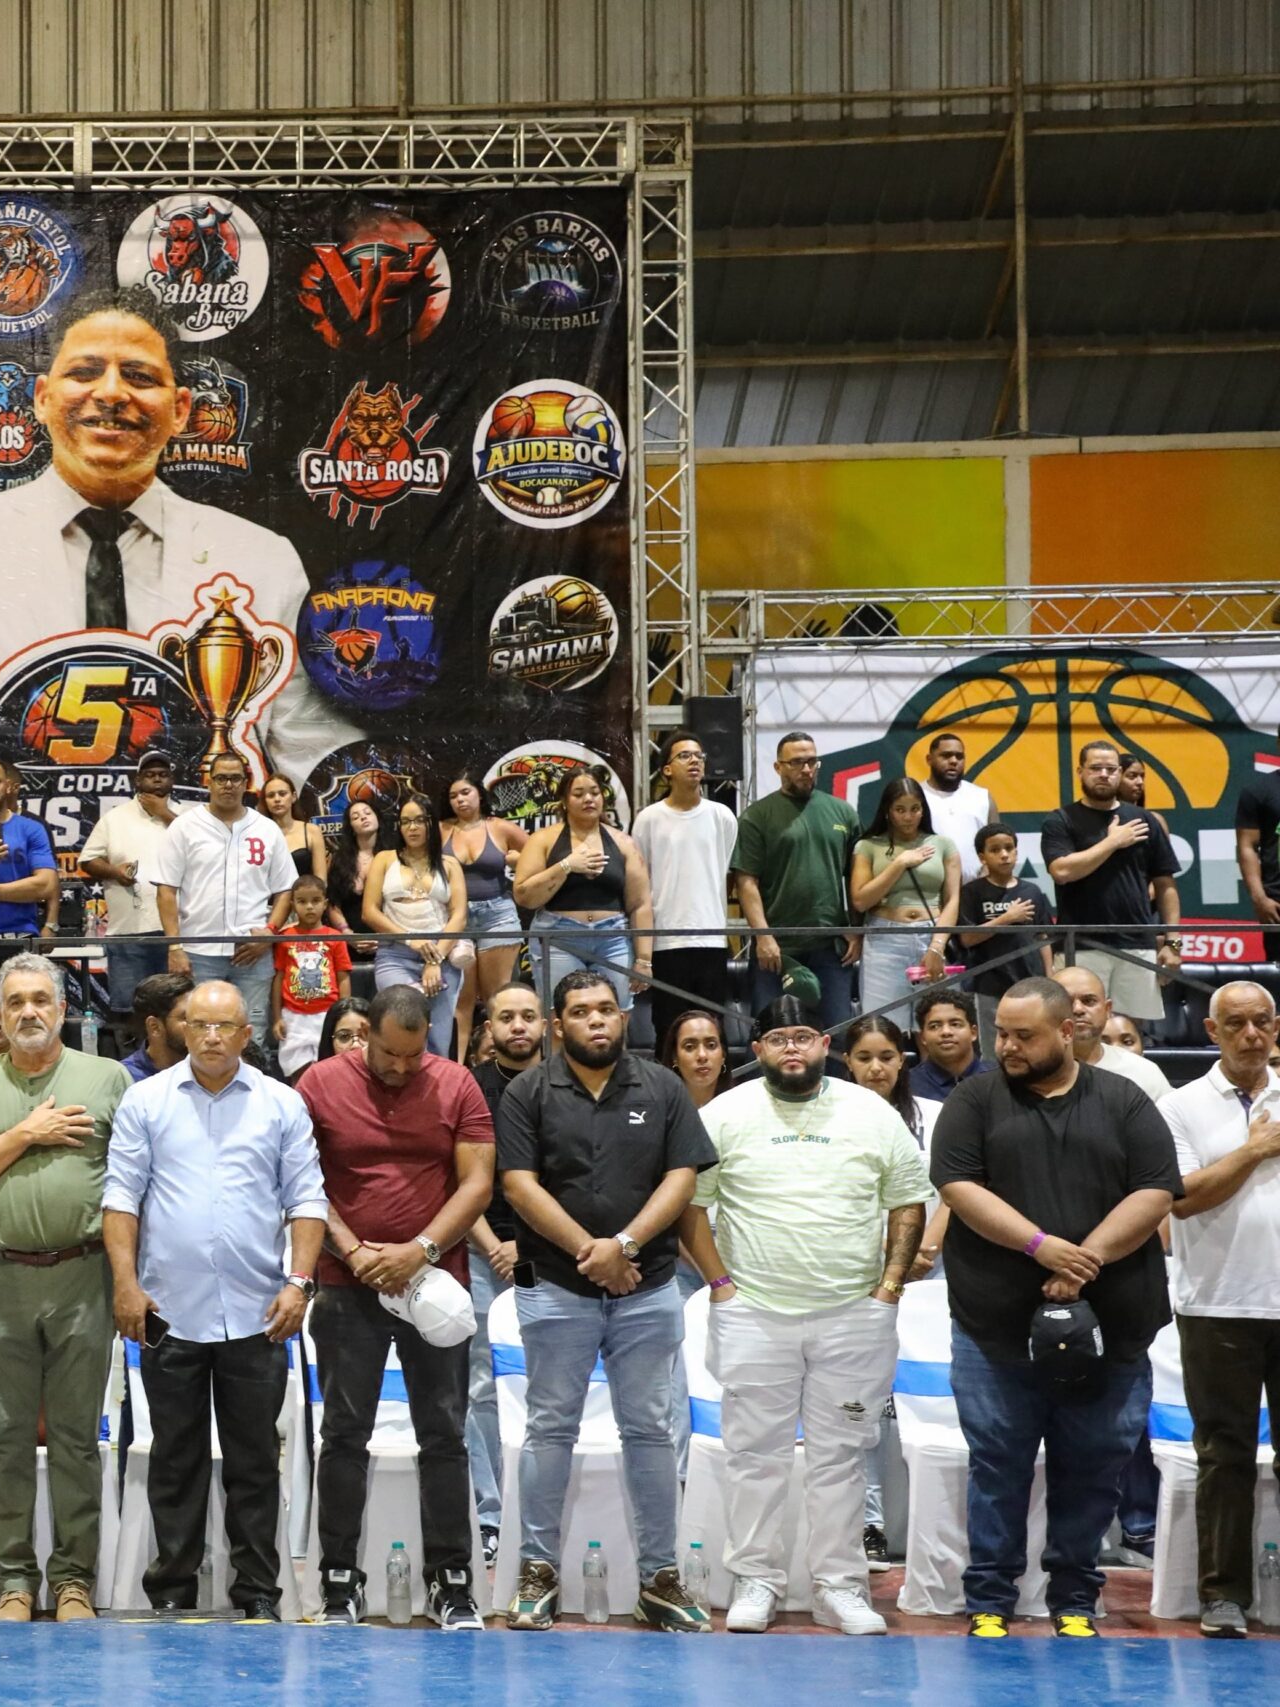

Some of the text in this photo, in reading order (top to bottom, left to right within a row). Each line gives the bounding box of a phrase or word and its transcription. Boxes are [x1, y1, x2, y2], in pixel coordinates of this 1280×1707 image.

[534, 217, 611, 263] BARIAS
[134, 270, 249, 306] Sabana
[186, 302, 248, 332] Buey
[500, 308, 601, 331] BASKETBALL
[162, 462, 222, 474] BASKETBALL
[163, 442, 248, 471] LA MAJEGA
[486, 439, 610, 473] AJUDEBOC
[309, 456, 440, 485] SANTA ROSA
[519, 477, 580, 488] BOCACANASTA
[309, 586, 438, 614] ANACAONA
[489, 634, 603, 675] SANTANA
[524, 656, 583, 674] BASKETBALL
[56, 773, 132, 794] COPA
[244, 836, 266, 866] B
[1181, 935, 1244, 960] ESTO
[770, 1134, 831, 1146] SLOW CREW
